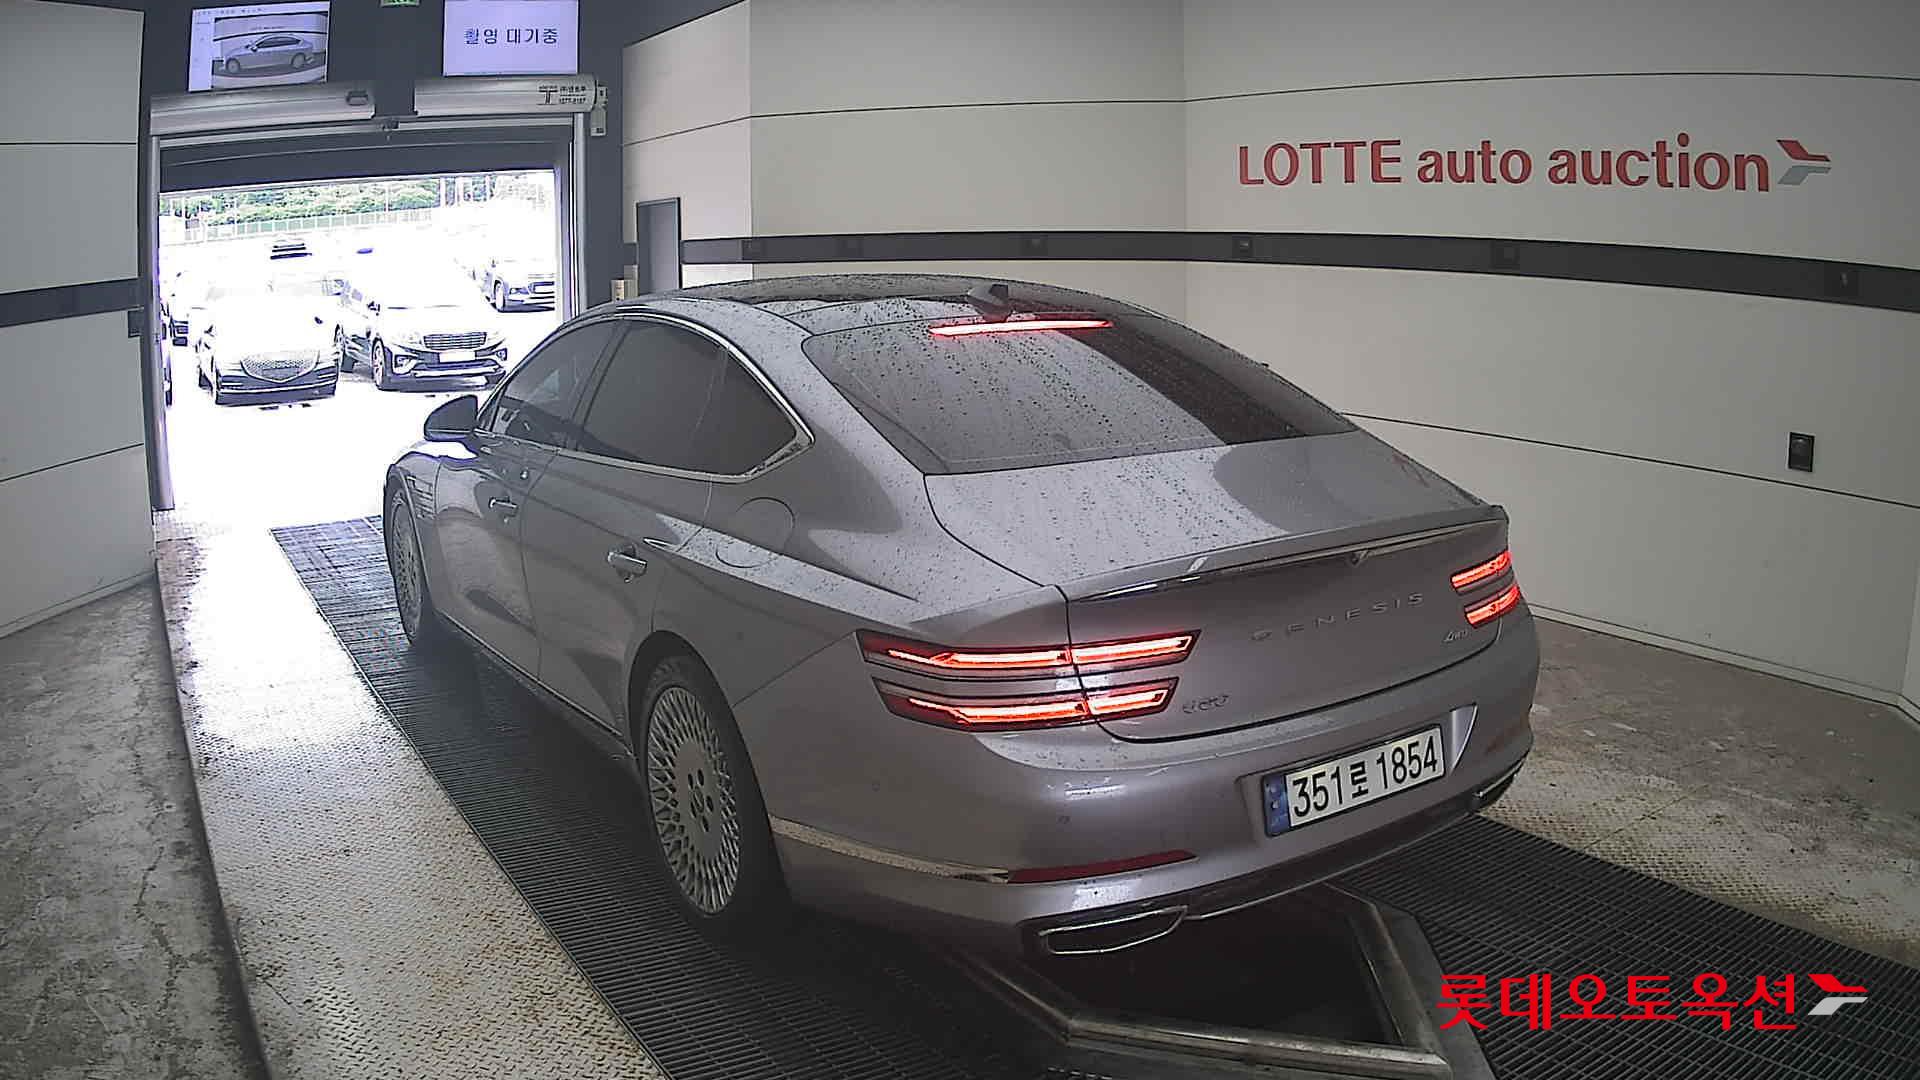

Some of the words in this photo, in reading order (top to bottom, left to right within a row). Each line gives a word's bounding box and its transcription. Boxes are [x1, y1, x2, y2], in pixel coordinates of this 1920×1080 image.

[506, 28, 557, 44] 대기중
[1240, 141, 1401, 185] LOTTE
[1417, 141, 1532, 184] auto
[1548, 134, 1770, 192] auction
[1251, 592, 1424, 640] GENESIS
[1292, 761, 1369, 817] 351로
[1376, 735, 1438, 789] 1854
